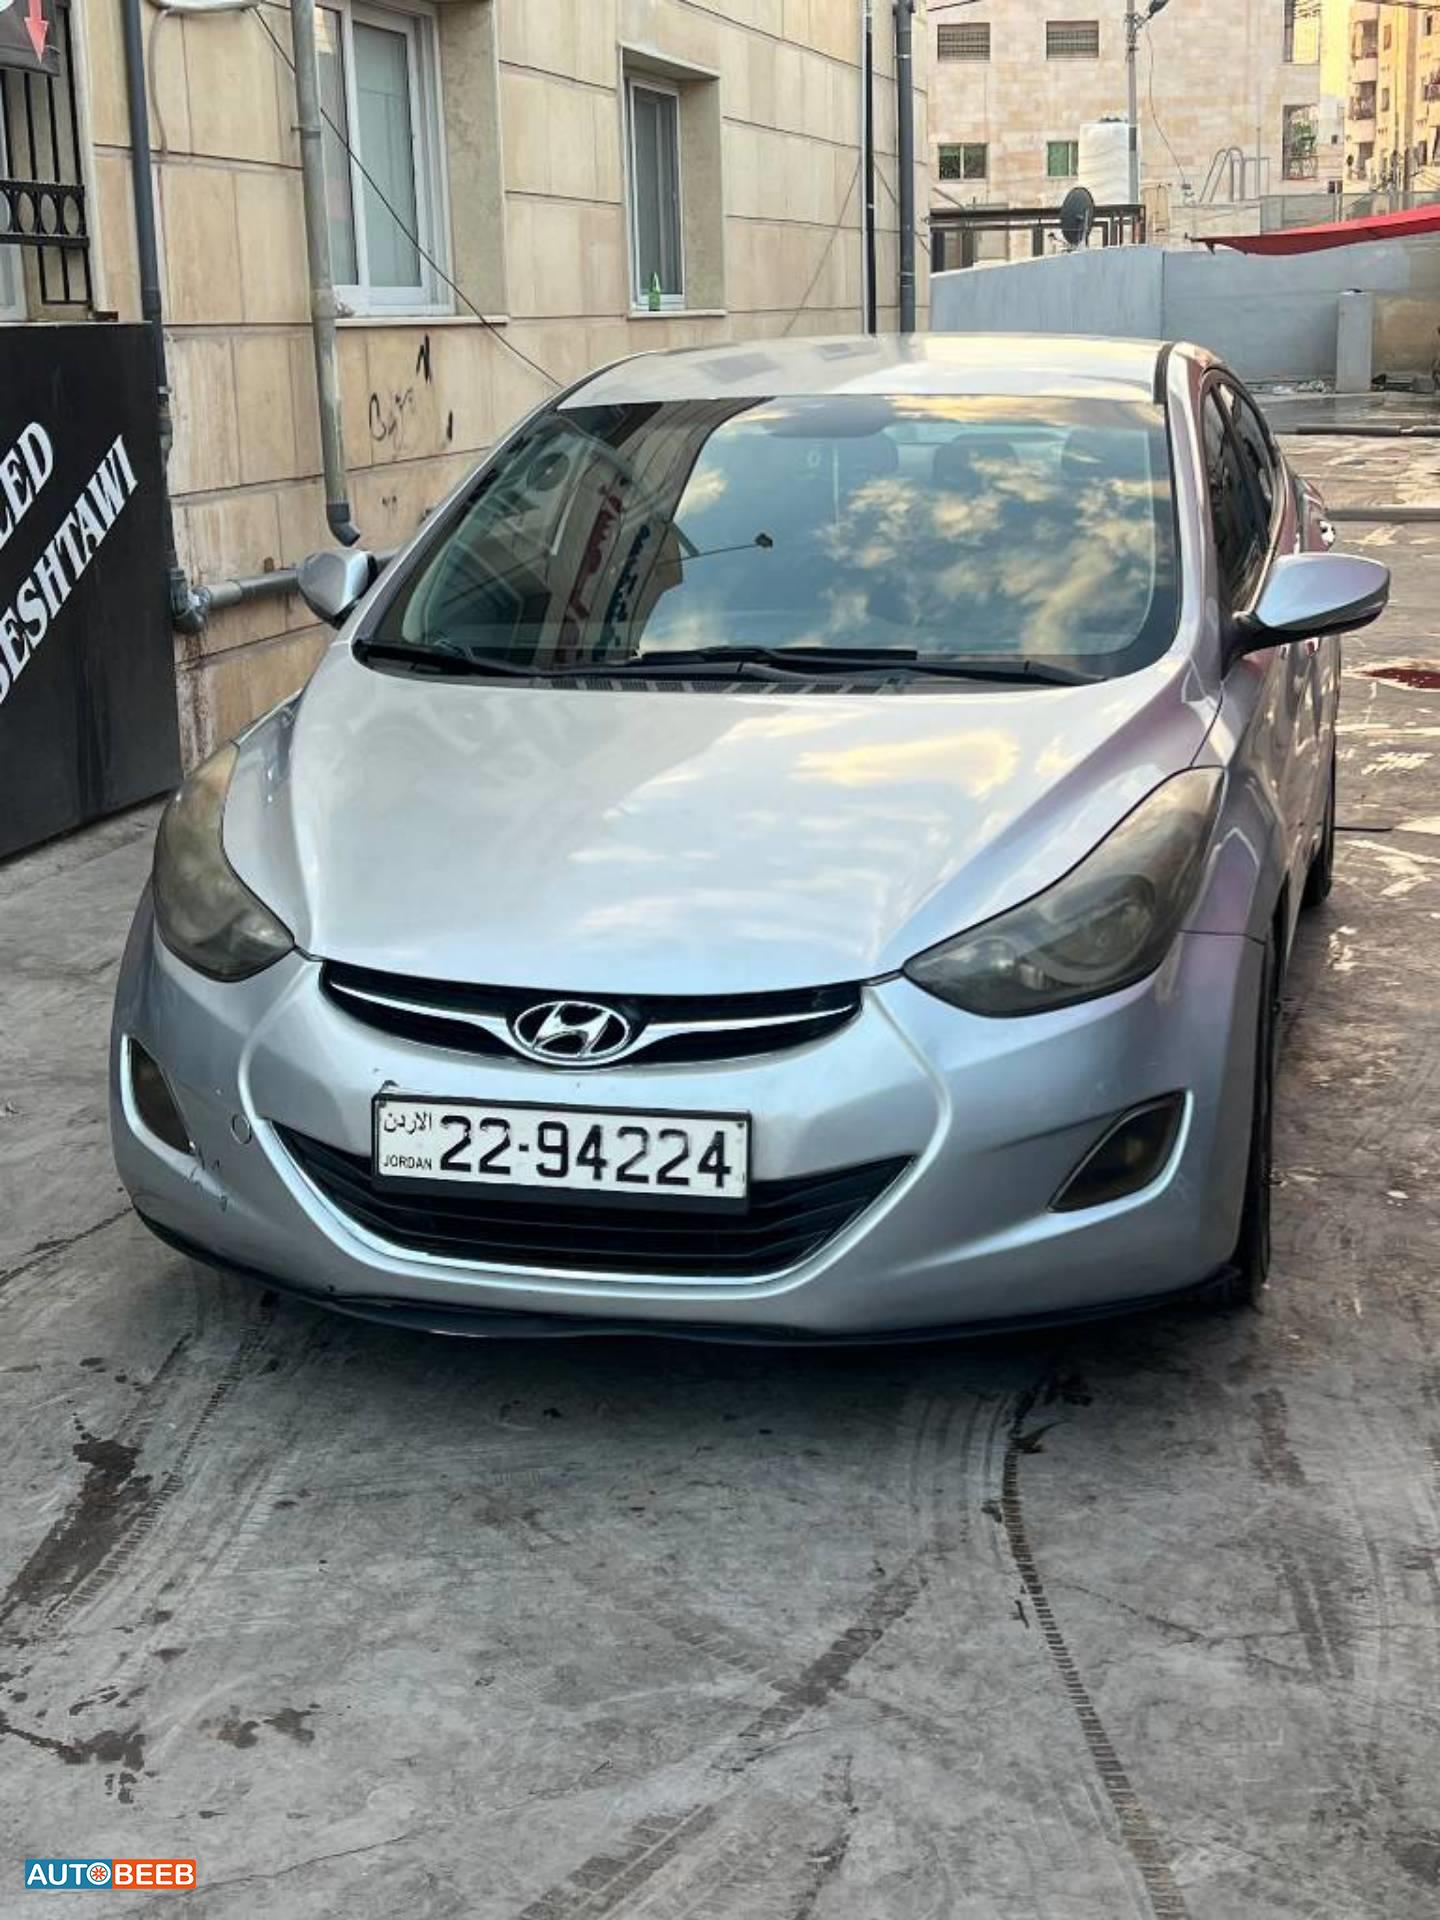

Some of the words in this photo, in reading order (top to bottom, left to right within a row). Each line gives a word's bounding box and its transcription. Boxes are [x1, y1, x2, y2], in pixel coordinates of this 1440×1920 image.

[384, 1111, 432, 1134] الاردن
[384, 1154, 432, 1171] JORDAN
[440, 1115, 732, 1188] 22-94224
